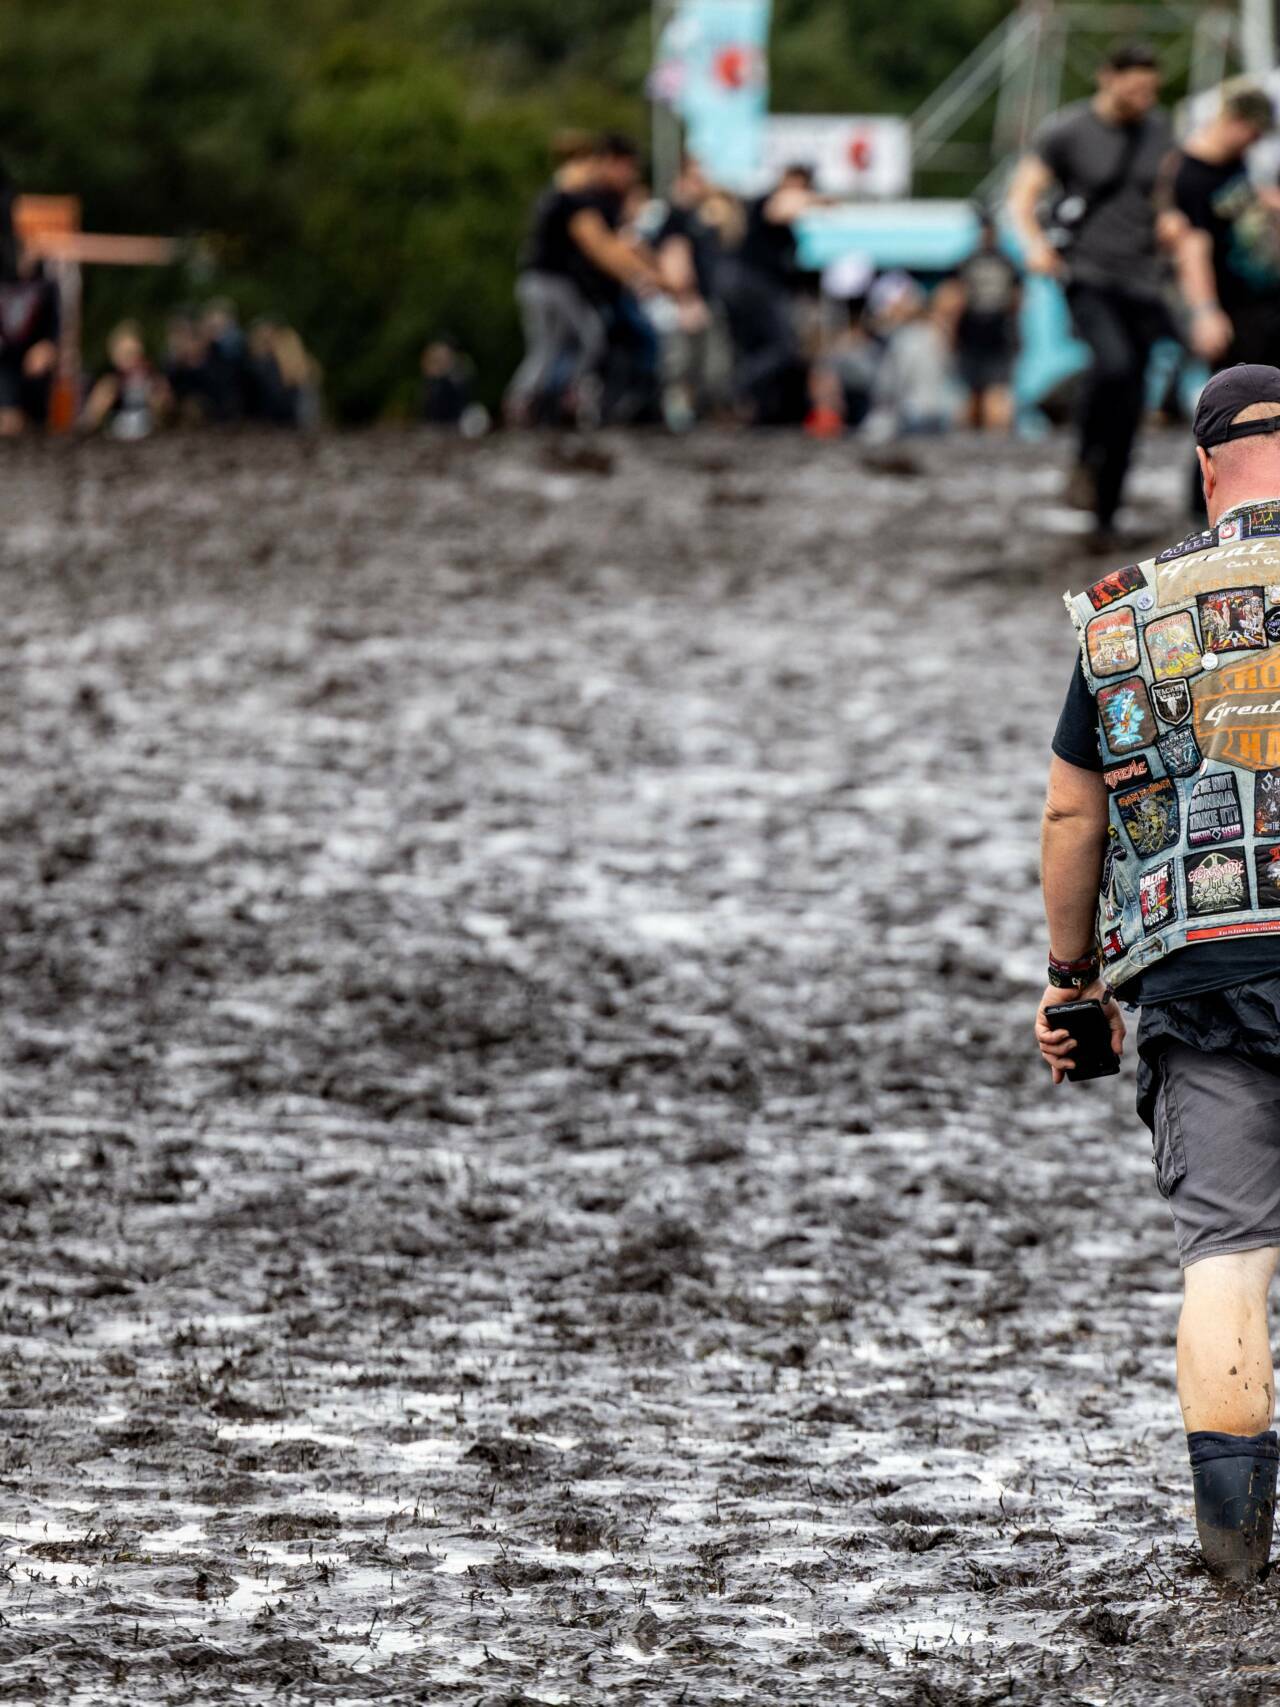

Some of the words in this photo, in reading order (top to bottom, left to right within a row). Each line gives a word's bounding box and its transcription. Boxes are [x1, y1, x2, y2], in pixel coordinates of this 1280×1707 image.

[1160, 536, 1213, 558] QUEEN
[1160, 542, 1277, 579] Great
[1154, 683, 1185, 697] WACKEN
[1211, 774, 1233, 791] NOT
[1188, 809, 1219, 831] TAKE
